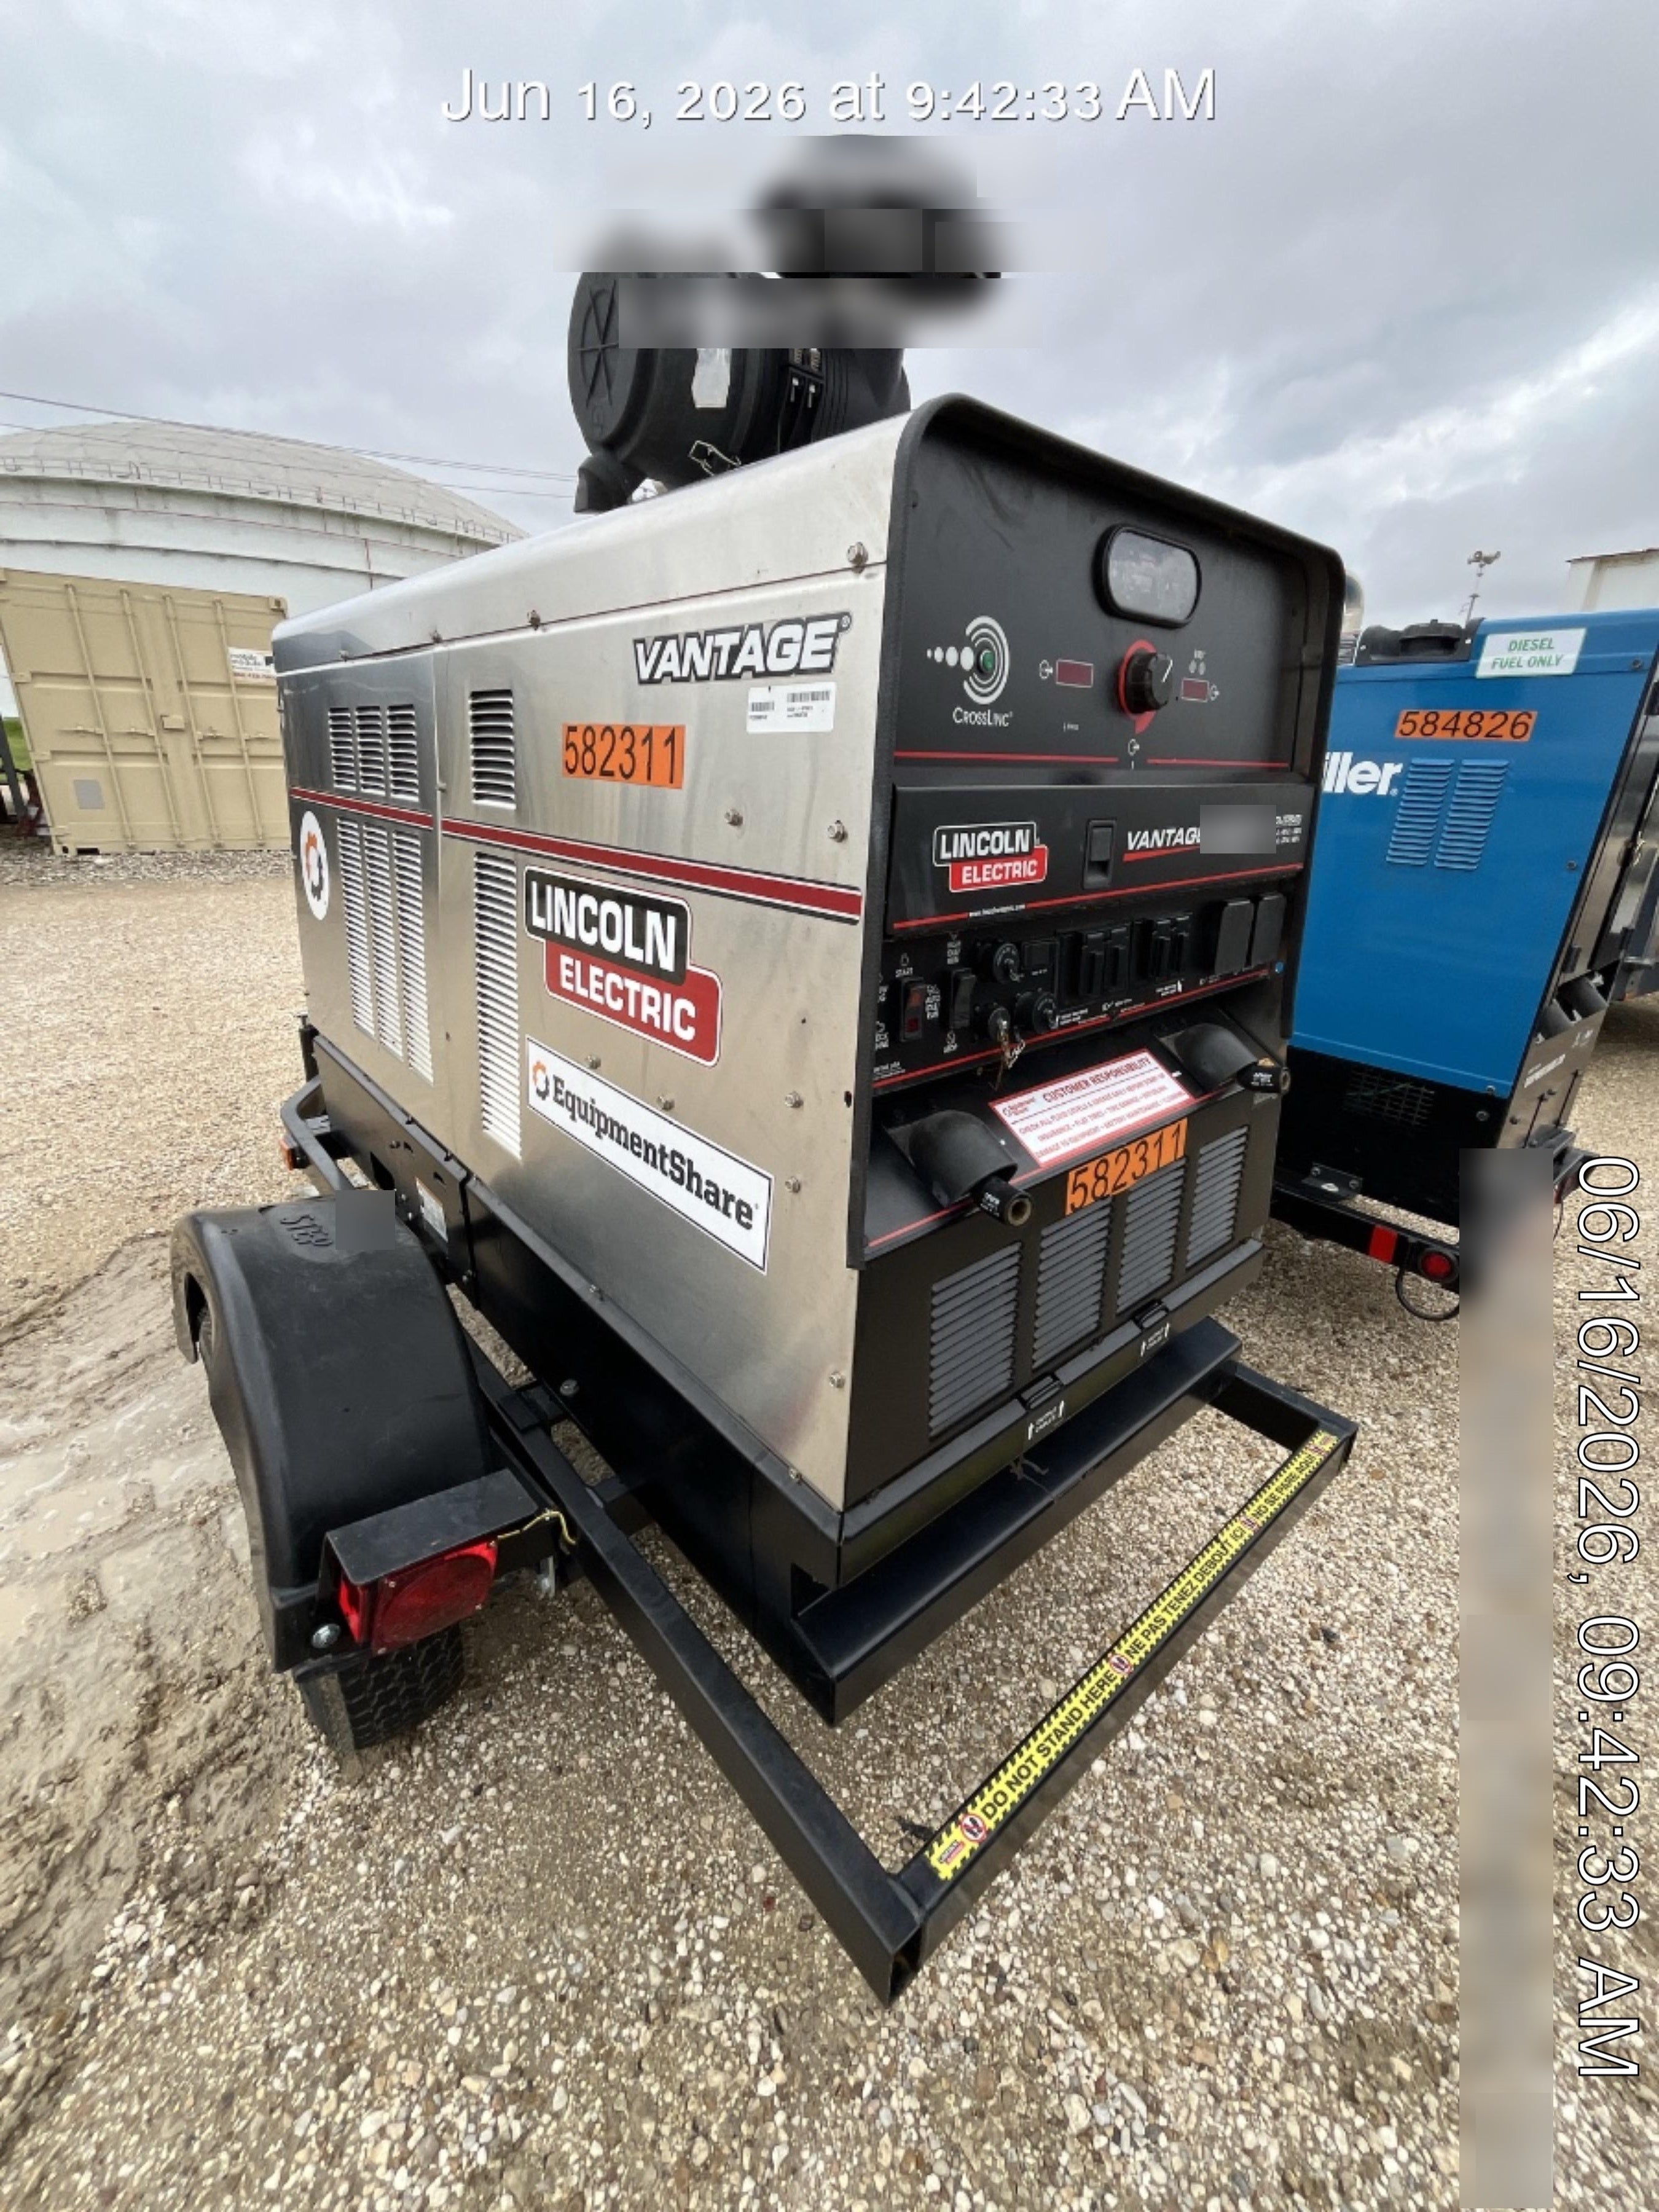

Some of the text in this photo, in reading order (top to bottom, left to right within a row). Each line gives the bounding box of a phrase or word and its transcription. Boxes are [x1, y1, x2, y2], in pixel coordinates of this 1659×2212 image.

[1490, 654, 1564, 670] FUEL ONLY
[1507, 637, 1555, 653] DIESEL
[1398, 710, 1533, 740] 584826
[564, 725, 677, 784] 582311
[940, 828, 1030, 860] LINCOLN
[1126, 826, 1200, 851] VANTAG
[961, 860, 1038, 885] ELECTRIC
[530, 879, 677, 973] LINCOLN
[559, 954, 696, 1043] ELECTRIC
[552, 1072, 754, 1232] EquipmentShare
[1069, 1123, 1182, 1212] 582311
[982, 1790, 1009, 1819] DO
[1005, 1756, 1042, 1791] NOT
[1036, 1706, 1084, 1760] STAND
[1082, 1672, 1118, 1708] HERE
[1127, 1639, 1147, 1660] NE
[1140, 1612, 1167, 1645] PAS
[1164, 1580, 1198, 1618] TENEZ
[1194, 1542, 1231, 1584] DEBOUT
[1230, 1527, 1246, 1543] ICI
